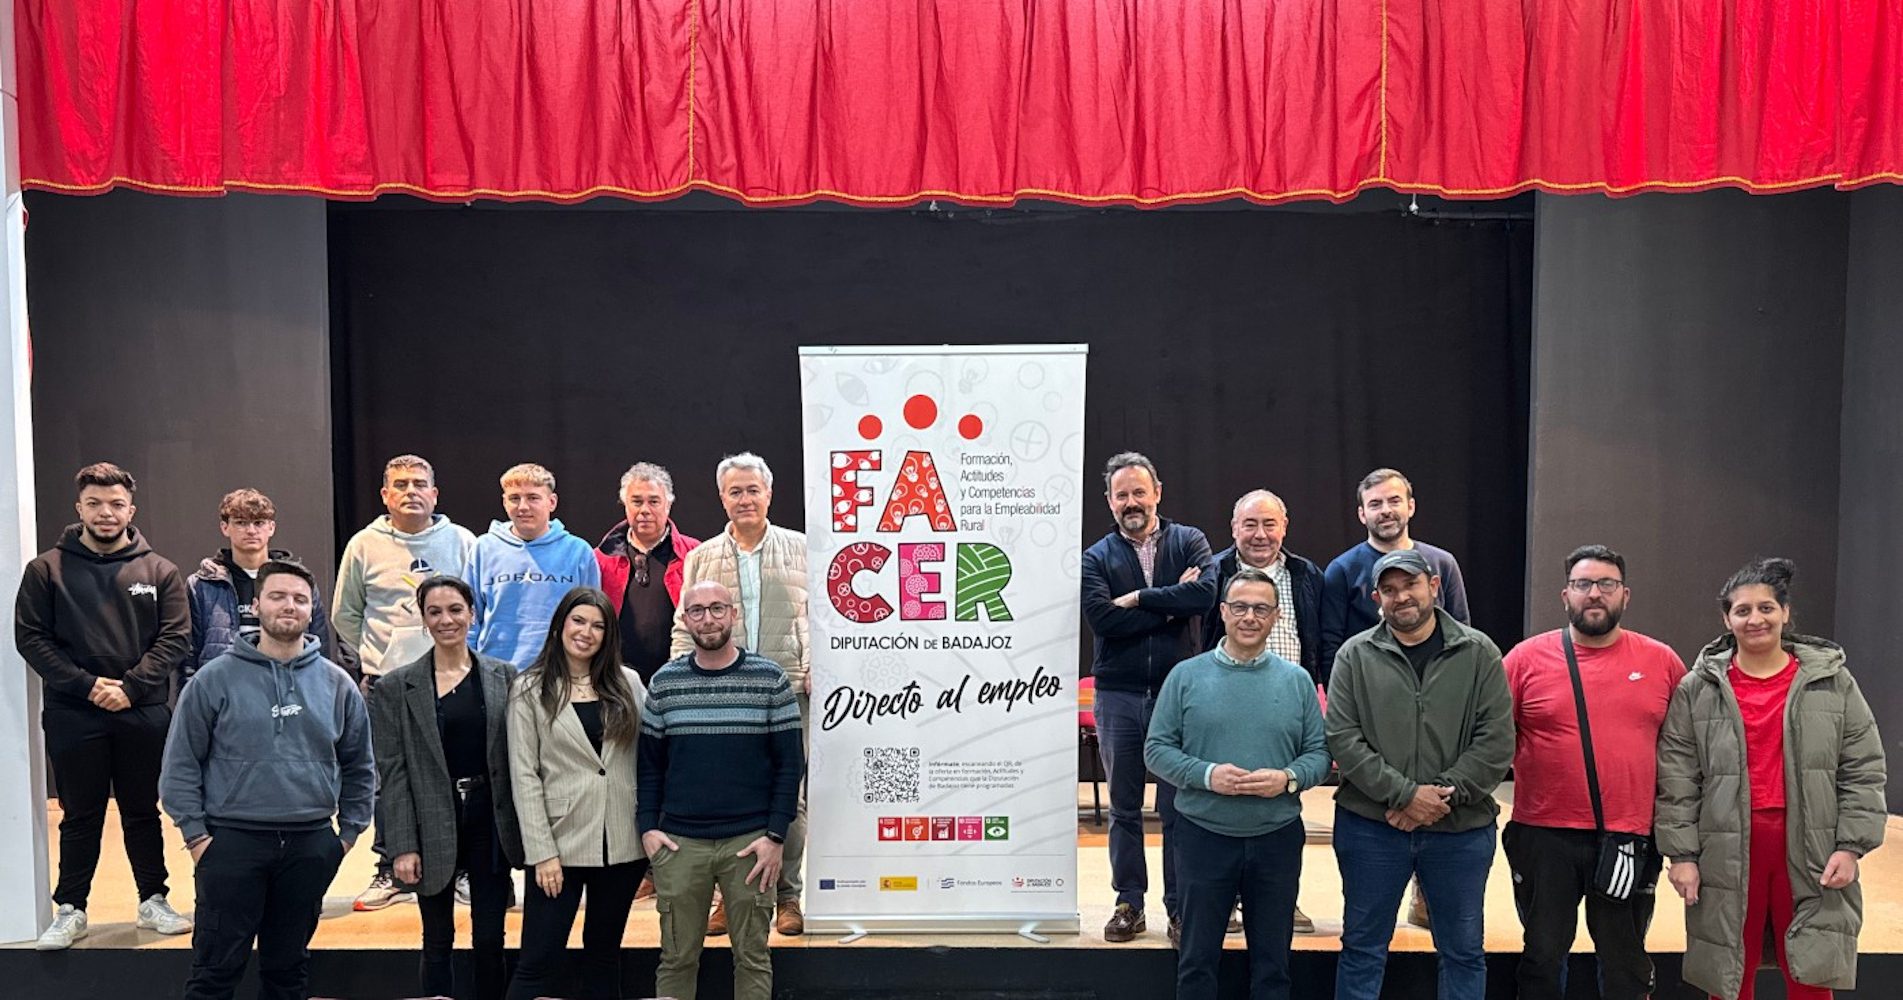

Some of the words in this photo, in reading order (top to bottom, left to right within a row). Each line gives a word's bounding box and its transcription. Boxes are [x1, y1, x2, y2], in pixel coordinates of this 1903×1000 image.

[960, 452, 1013, 466] Formación,
[960, 470, 1004, 482] Actitudes
[830, 450, 957, 532] FA
[960, 489, 966, 500] y
[968, 486, 1035, 500] Competencias
[960, 505, 981, 517] para
[984, 503, 992, 515] la
[995, 502, 1060, 517] Empleabilidad
[960, 519, 985, 531] Rural
[484, 572, 573, 586] JORDAN
[827, 541, 1014, 623] CER
[830, 632, 919, 650] DIPUTACIÓN
[942, 635, 1013, 650] BADAJOZ
[821, 680, 924, 731] Directo
[936, 674, 970, 714] al
[977, 665, 1063, 713] empleo
